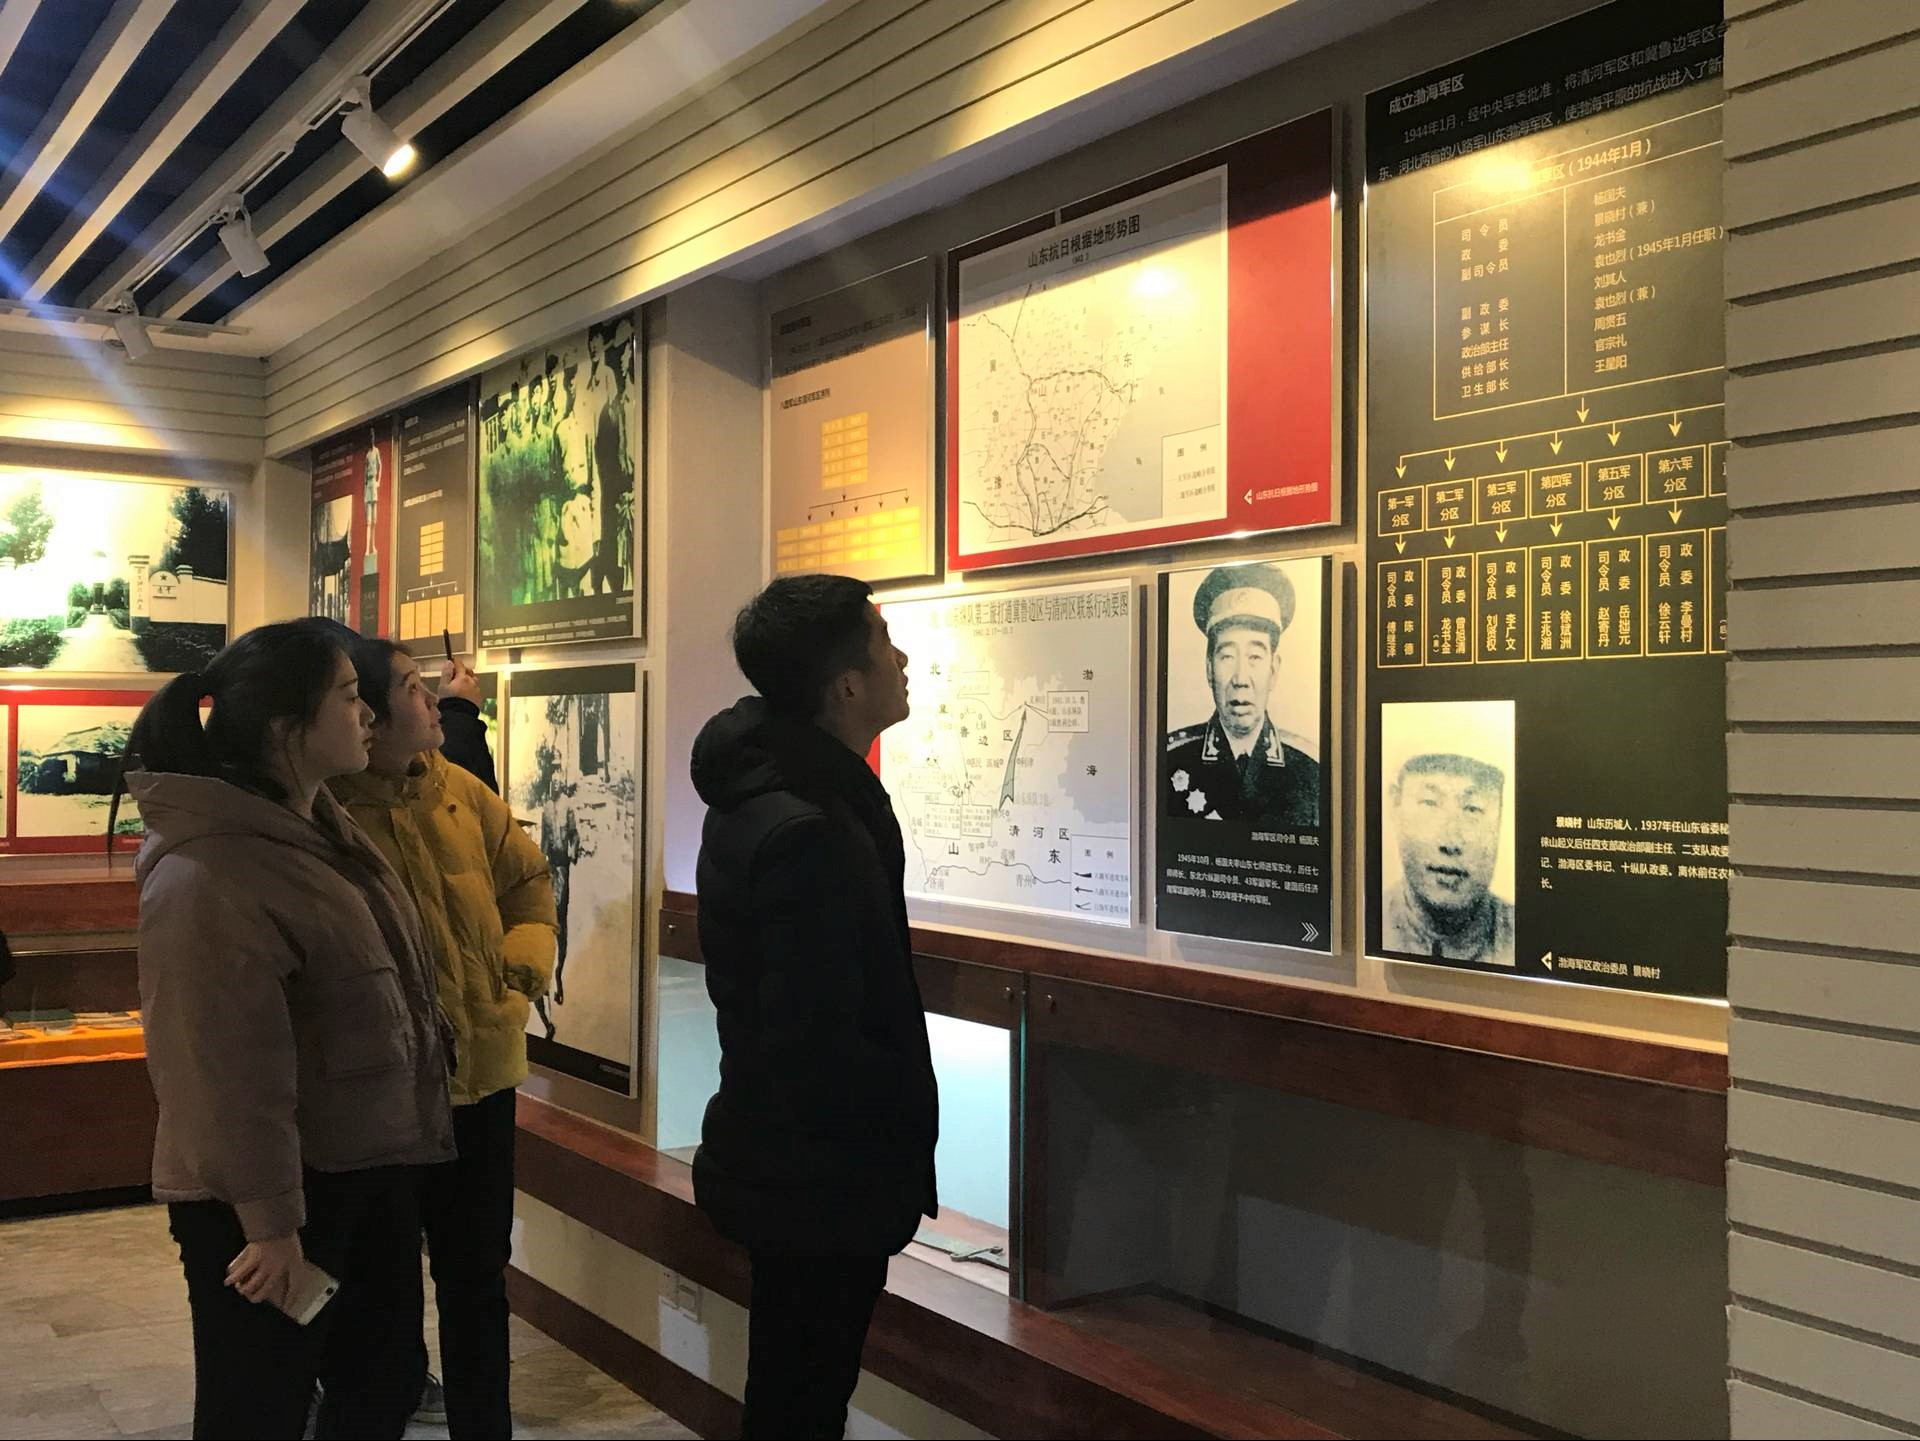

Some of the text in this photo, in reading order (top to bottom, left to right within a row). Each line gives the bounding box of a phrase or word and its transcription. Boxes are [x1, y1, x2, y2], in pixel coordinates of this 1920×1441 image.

[1388, 73, 1465, 116] 成立渤海军区
[1027, 214, 1141, 269] 山东抗日根据地形势图
[1594, 228, 1627, 248] 龙书金
[1461, 318, 1509, 341] 参谋长
[1461, 338, 1509, 360] 政治部主任
[1461, 358, 1510, 379] 供给部长
[1461, 378, 1510, 399] 卫生部长
[1598, 464, 1631, 482] 第五军
[1658, 456, 1693, 474] 第六军
[1487, 480, 1517, 497] 第三军
[1541, 472, 1572, 490] 第四军
[1664, 477, 1687, 493] 分区
[1387, 495, 1414, 511] 第一军
[1436, 487, 1464, 503] 第二军
[1546, 493, 1567, 508] 分区
[1604, 486, 1624, 501] 分区
[1440, 507, 1459, 521] 分区
[1492, 500, 1511, 515] 分区
[1391, 513, 1410, 527] 分区
[1598, 551, 1609, 592] 司令员
[1658, 545, 1671, 587] 司令员
[1440, 567, 1452, 604] 司令员
[1486, 562, 1497, 600] 司令员
[1540, 557, 1552, 596] 司令员
[1386, 571, 1397, 608] 司令员
[1505, 613, 1516, 651] 李广文
[1541, 878, 1553, 889] 长。
